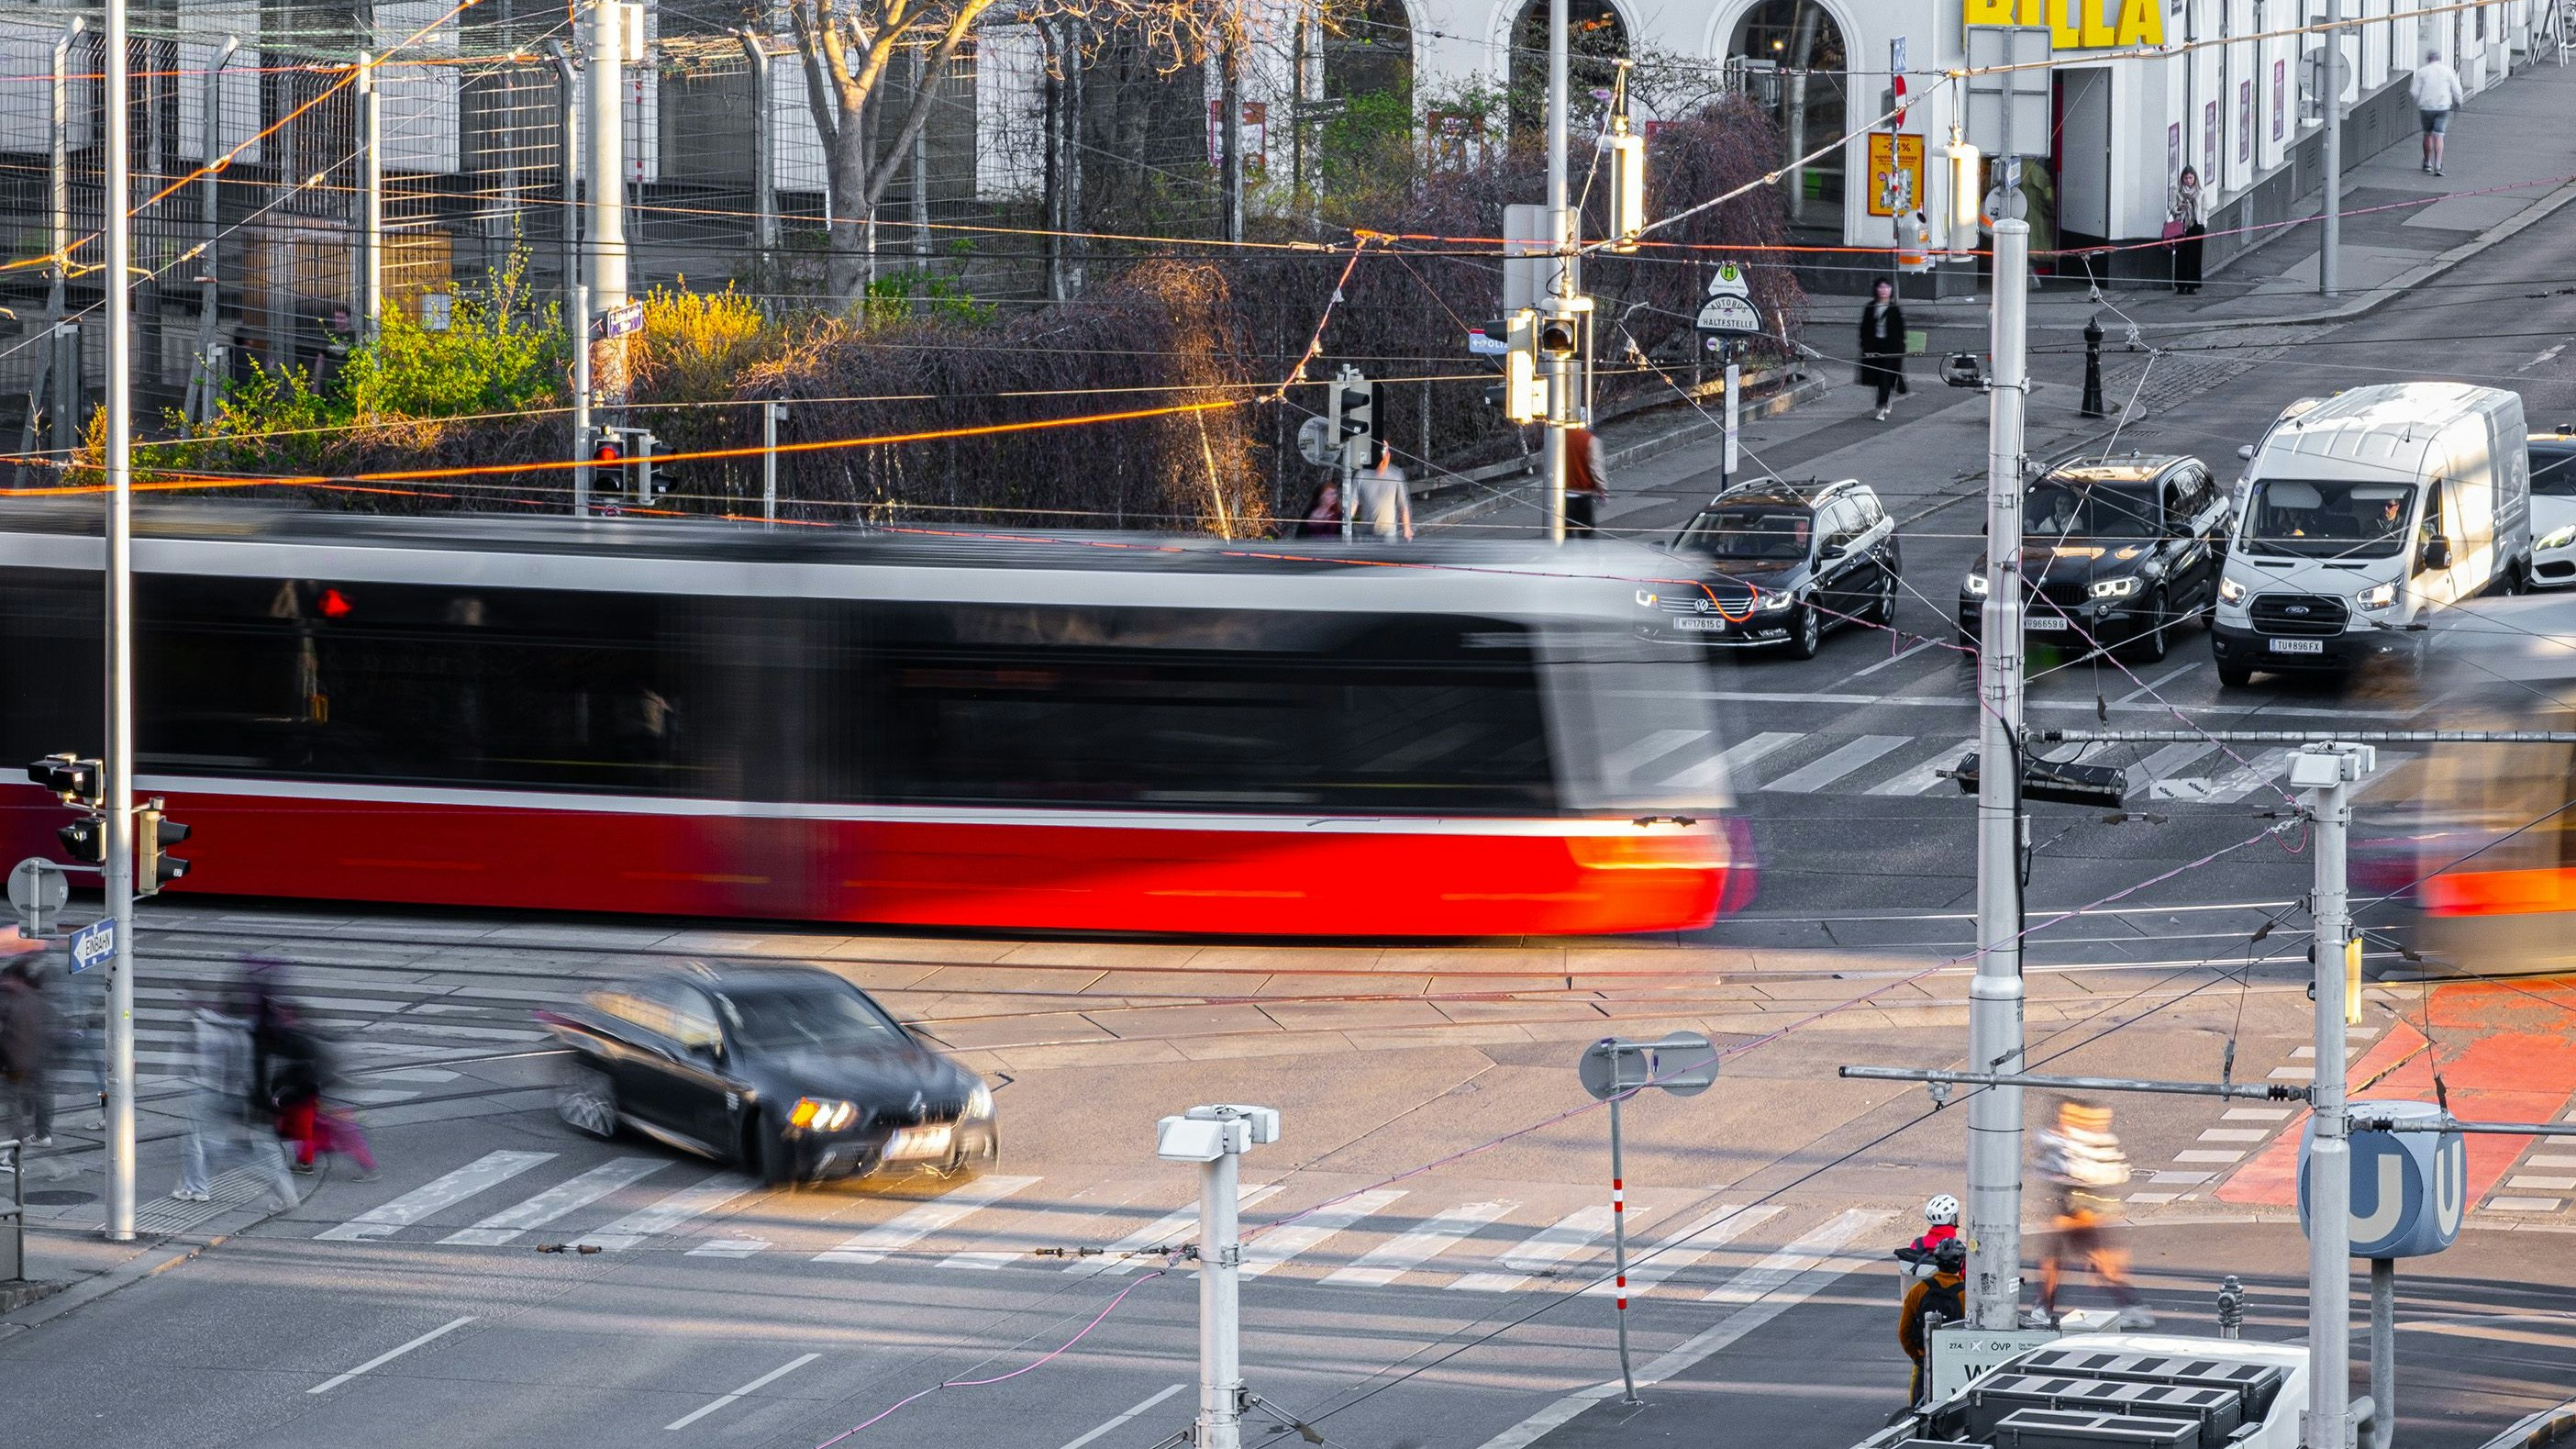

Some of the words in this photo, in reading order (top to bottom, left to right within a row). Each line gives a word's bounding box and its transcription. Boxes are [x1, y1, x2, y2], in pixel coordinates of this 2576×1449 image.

[1710, 298, 1749, 314] AUTOBUS
[1703, 318, 1754, 329] HALTESTELLE
[86, 931, 110, 955] EINBAHN
[2436, 1139, 2461, 1237] U
[1991, 1342, 2011, 1351] ÖVP
